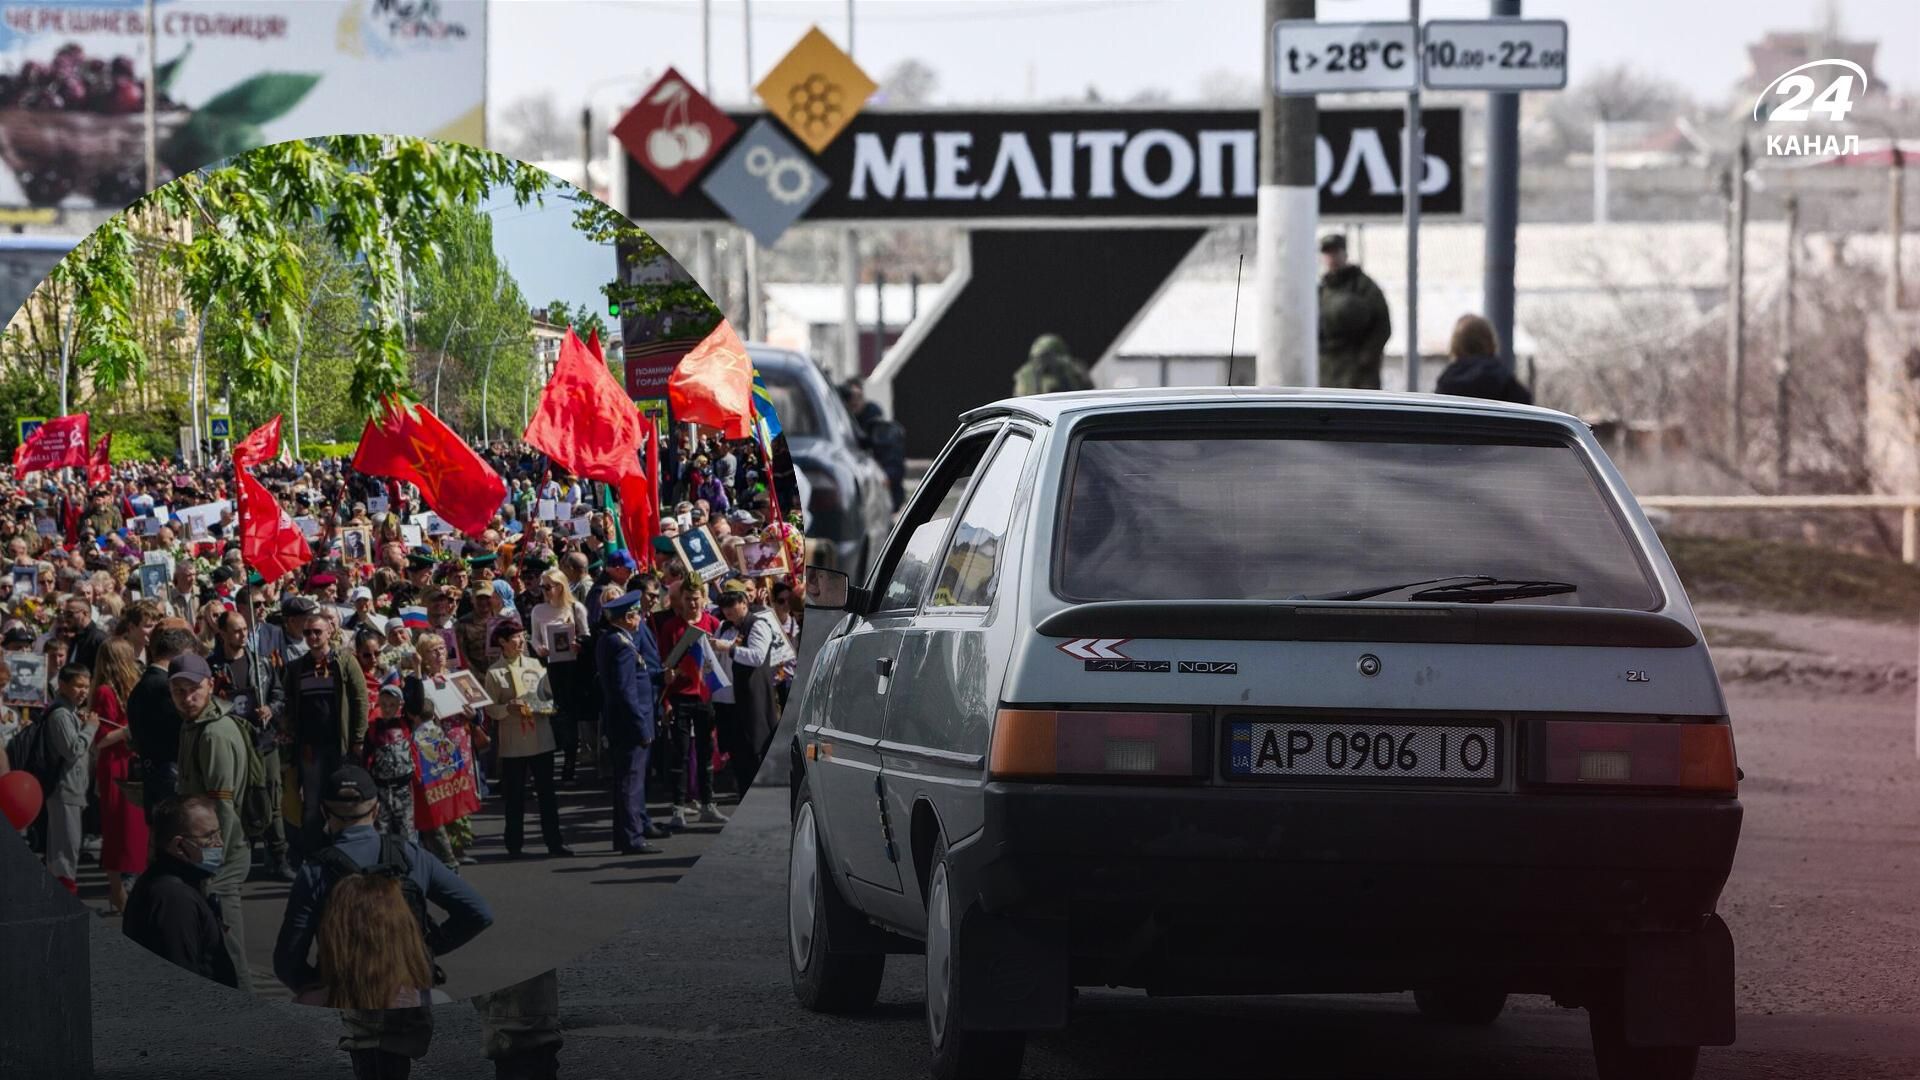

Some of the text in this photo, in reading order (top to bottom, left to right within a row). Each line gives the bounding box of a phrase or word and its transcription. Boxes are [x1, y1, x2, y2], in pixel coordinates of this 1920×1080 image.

[849, 128, 1451, 199] МЕЛІТОПЛЬ
[1179, 661, 1237, 674] NOVA
[1626, 670, 1650, 682] 2L
[1255, 729, 1314, 769] AP
[1325, 730, 1419, 771] 0906
